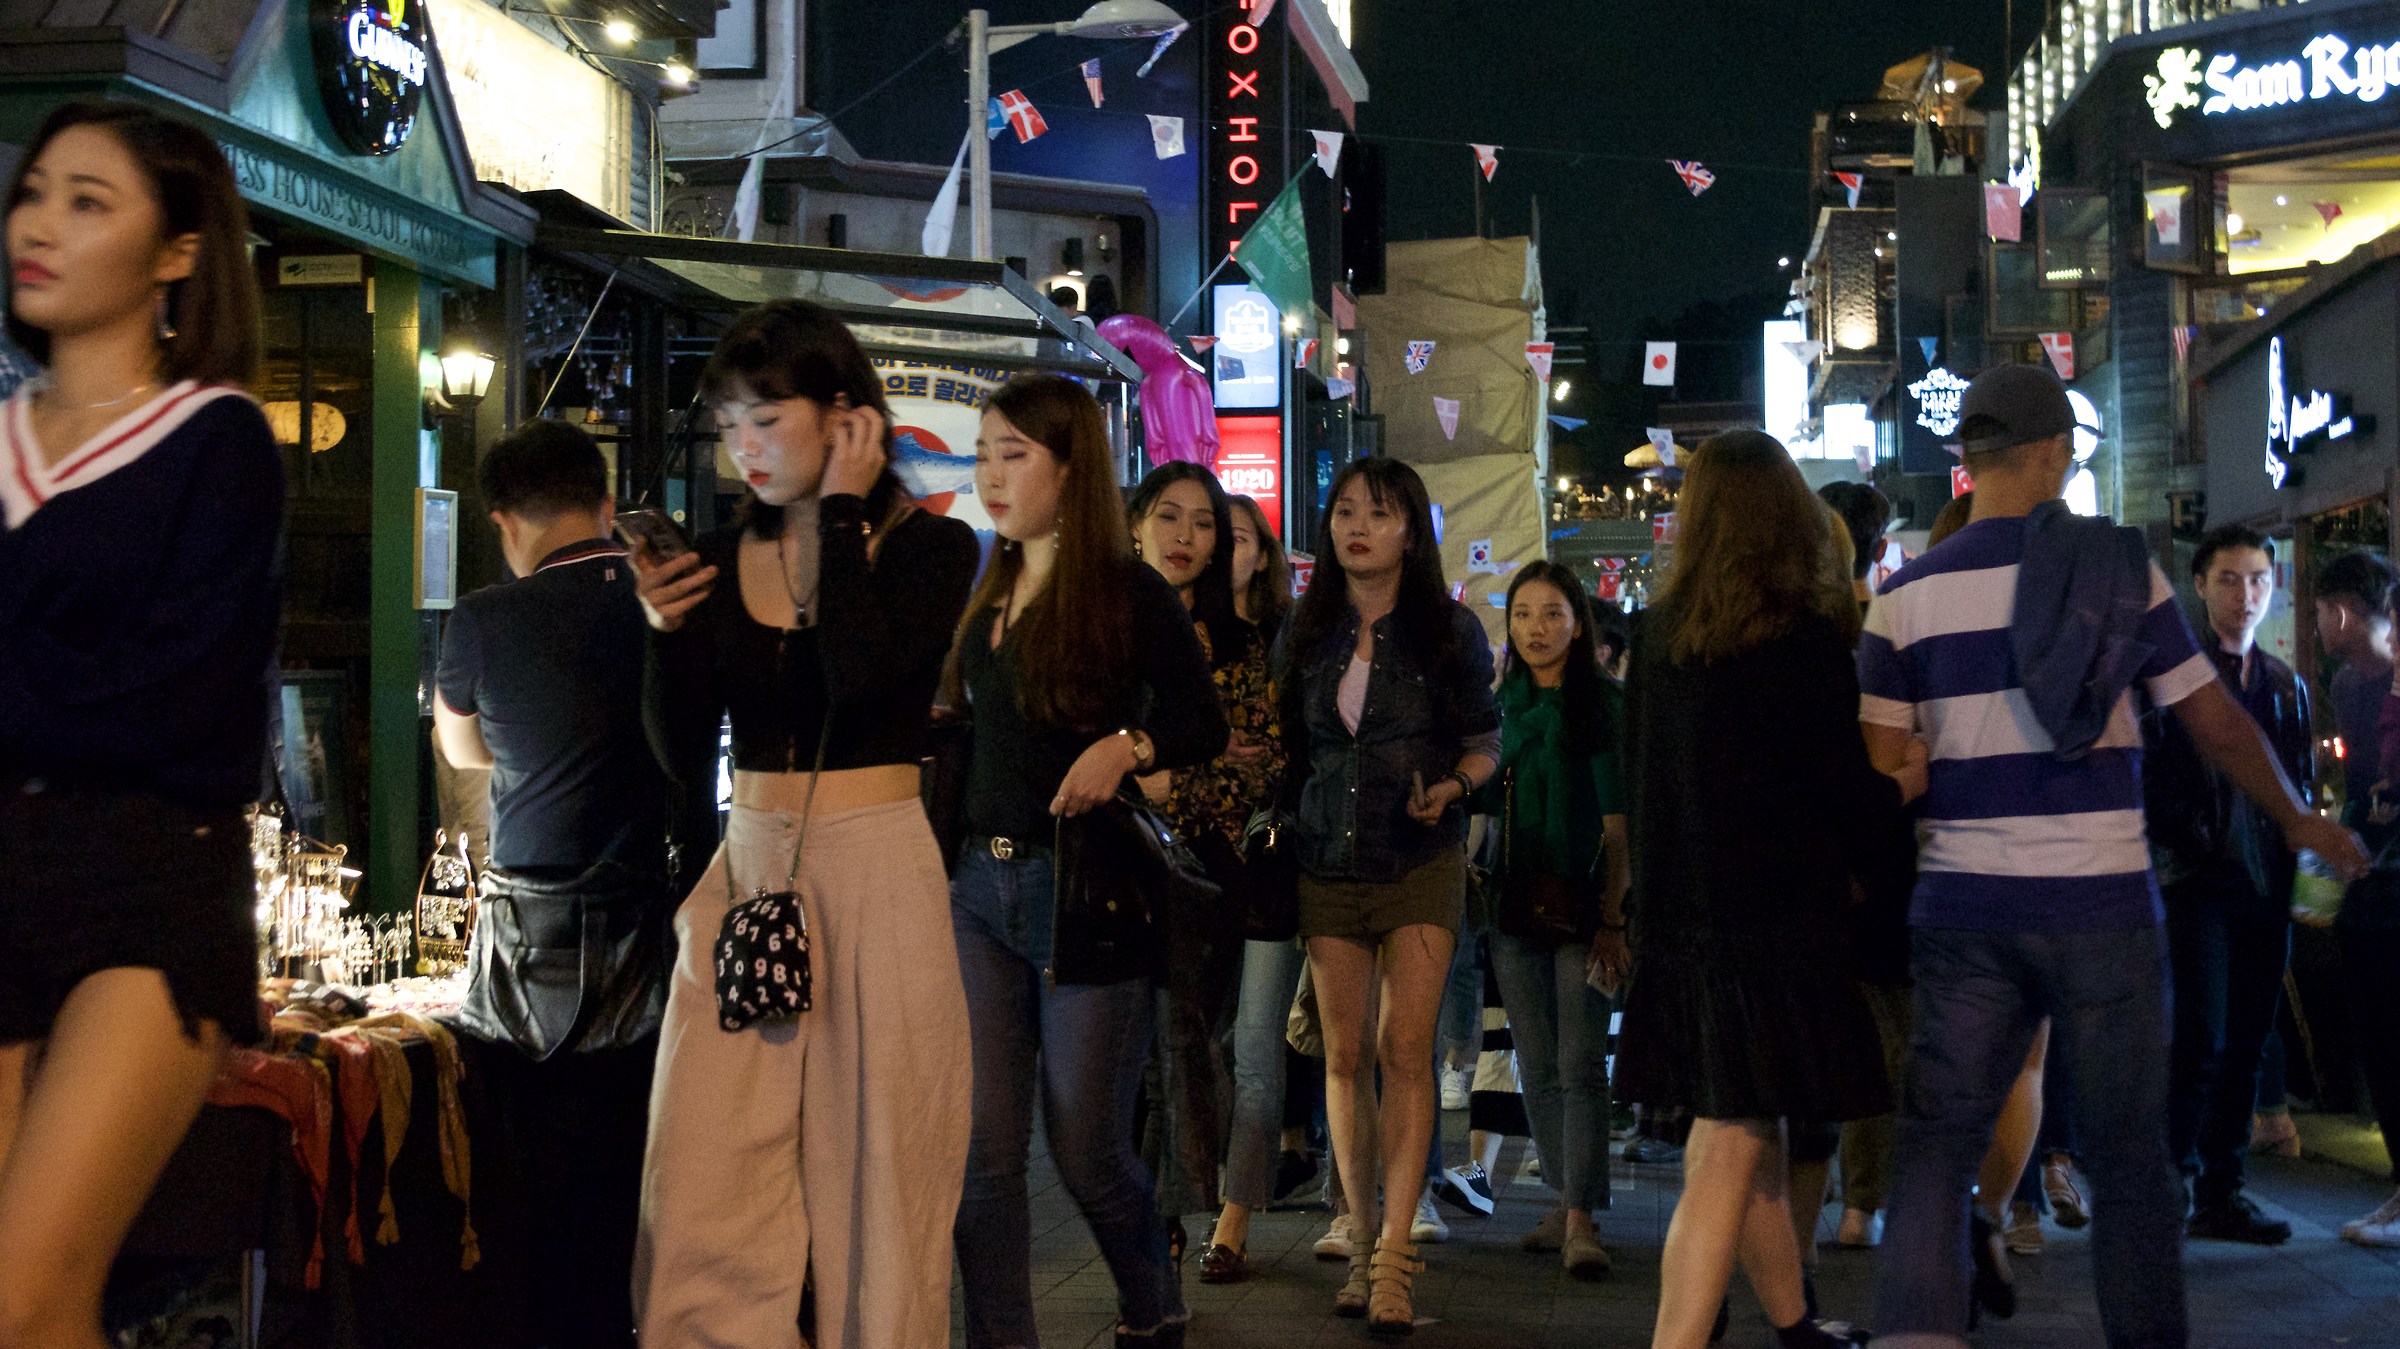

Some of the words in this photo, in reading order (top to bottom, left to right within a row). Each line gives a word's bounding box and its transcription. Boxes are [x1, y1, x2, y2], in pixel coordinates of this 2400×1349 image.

[2203, 52, 2304, 116] Sam
[1228, 0, 1258, 262] OXHOL
[272, 161, 345, 221] HOUSE
[349, 196, 409, 246] SEOUL
[1921, 398, 1961, 413] MING
[1221, 468, 1275, 492] 1920
[755, 958, 767, 978] 9
[773, 963, 787, 983] 8
